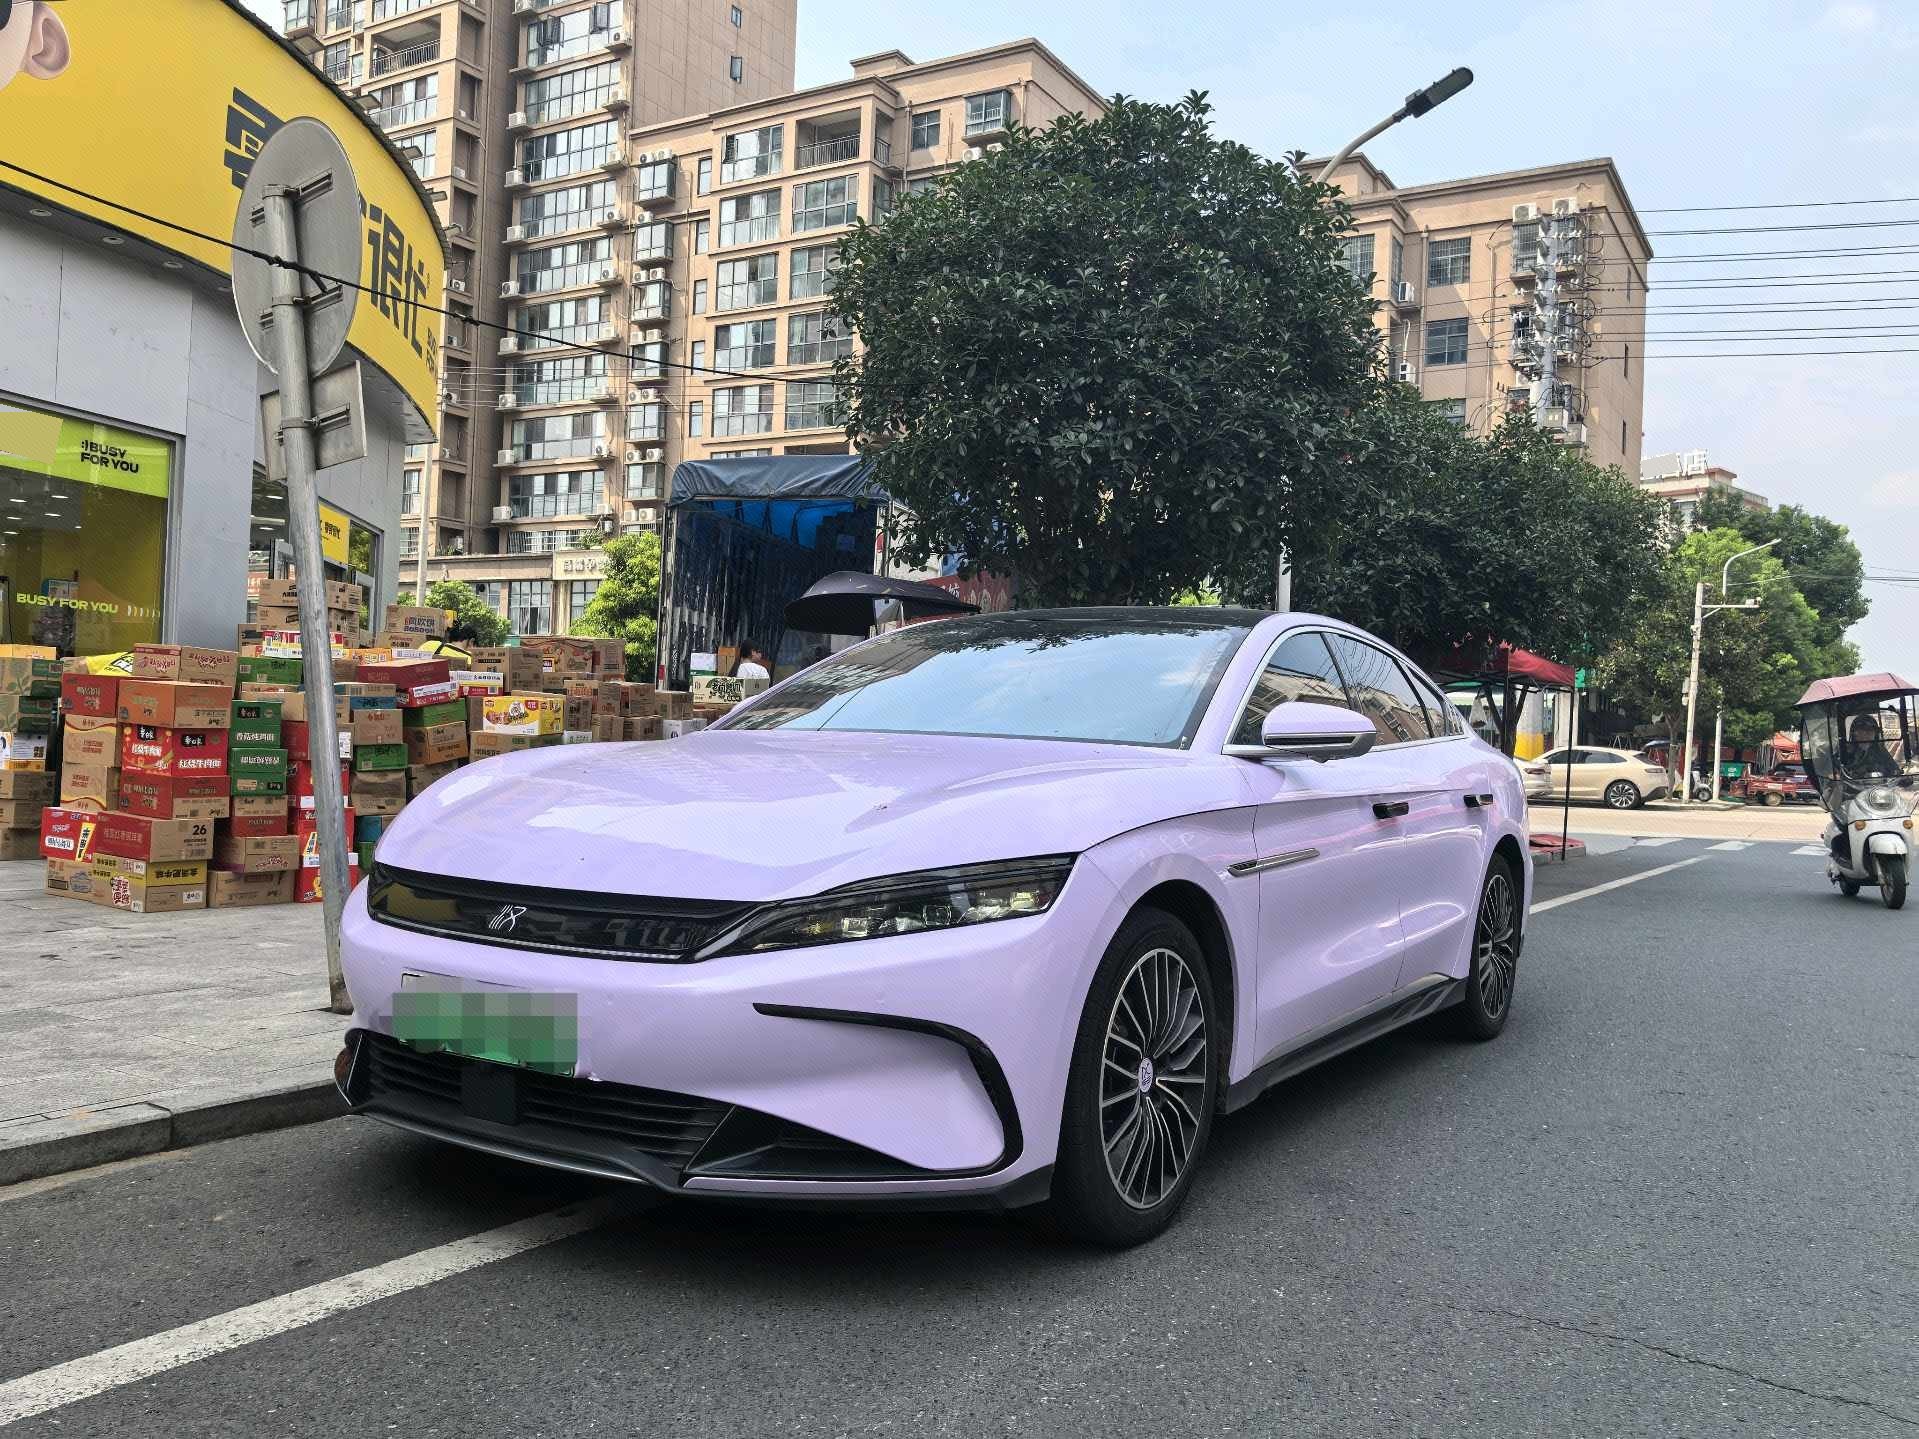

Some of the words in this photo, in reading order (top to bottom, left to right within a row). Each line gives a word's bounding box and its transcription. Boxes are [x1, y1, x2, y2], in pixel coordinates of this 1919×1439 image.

[81, 453, 109, 467] FOR
[111, 459, 138, 473] YOU
[16, 592, 57, 607] BUSY
[59, 599, 88, 611] FOR
[90, 601, 118, 613] YOU
[192, 825, 207, 836] 26
